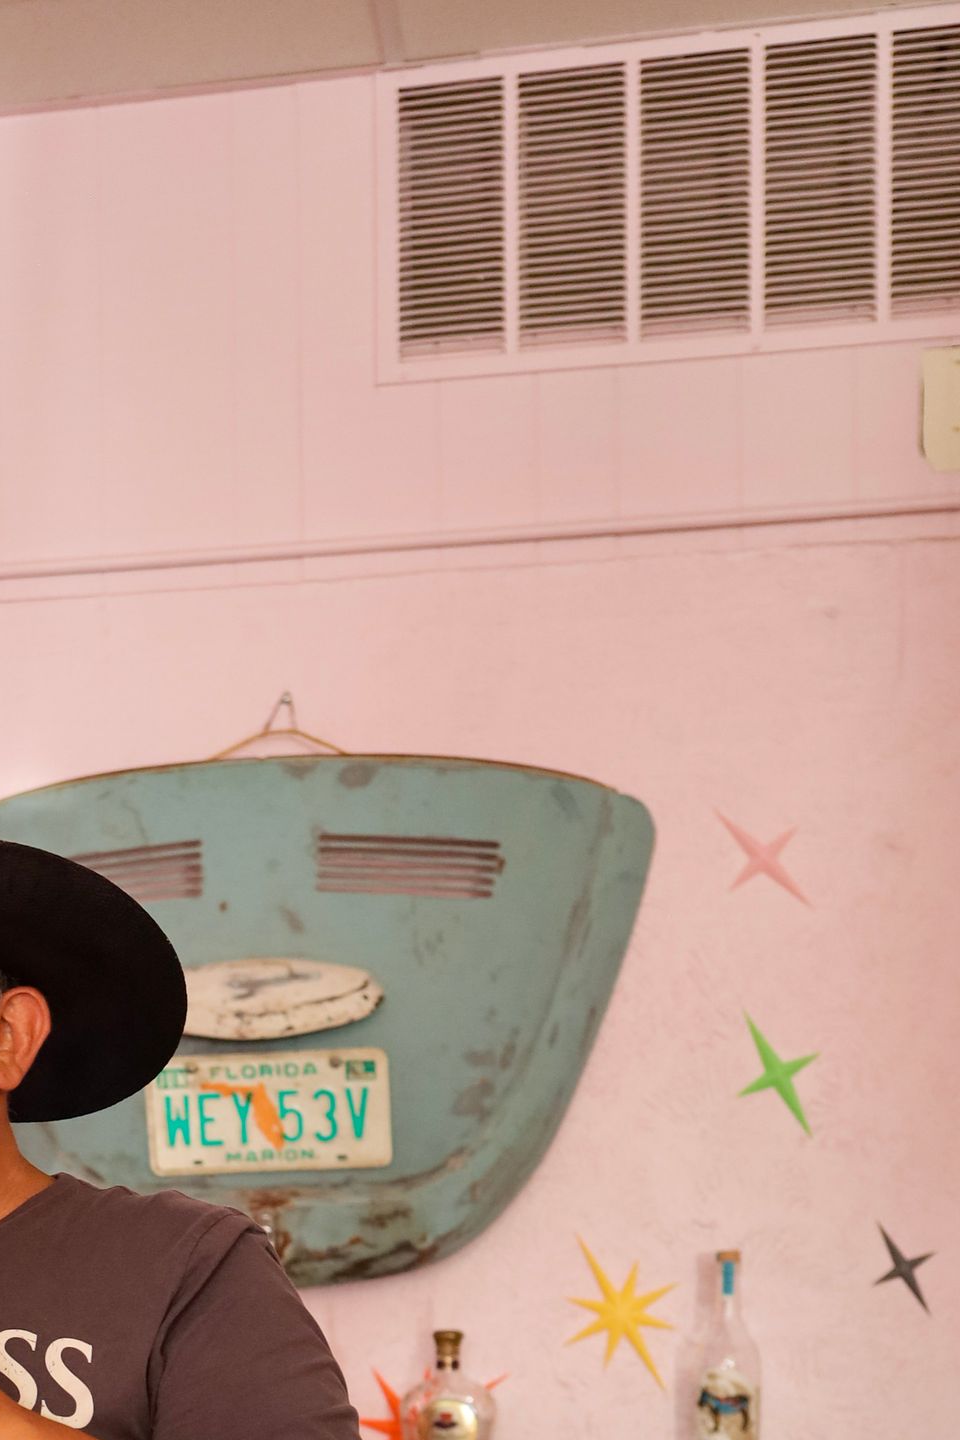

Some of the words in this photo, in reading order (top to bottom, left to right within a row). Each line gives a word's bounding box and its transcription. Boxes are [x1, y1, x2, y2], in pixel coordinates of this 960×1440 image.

[208, 1062, 318, 1081] FLORIDA
[164, 1091, 253, 1147] WEY
[277, 1087, 369, 1142] 53V
[225, 1148, 315, 1163] MARION
